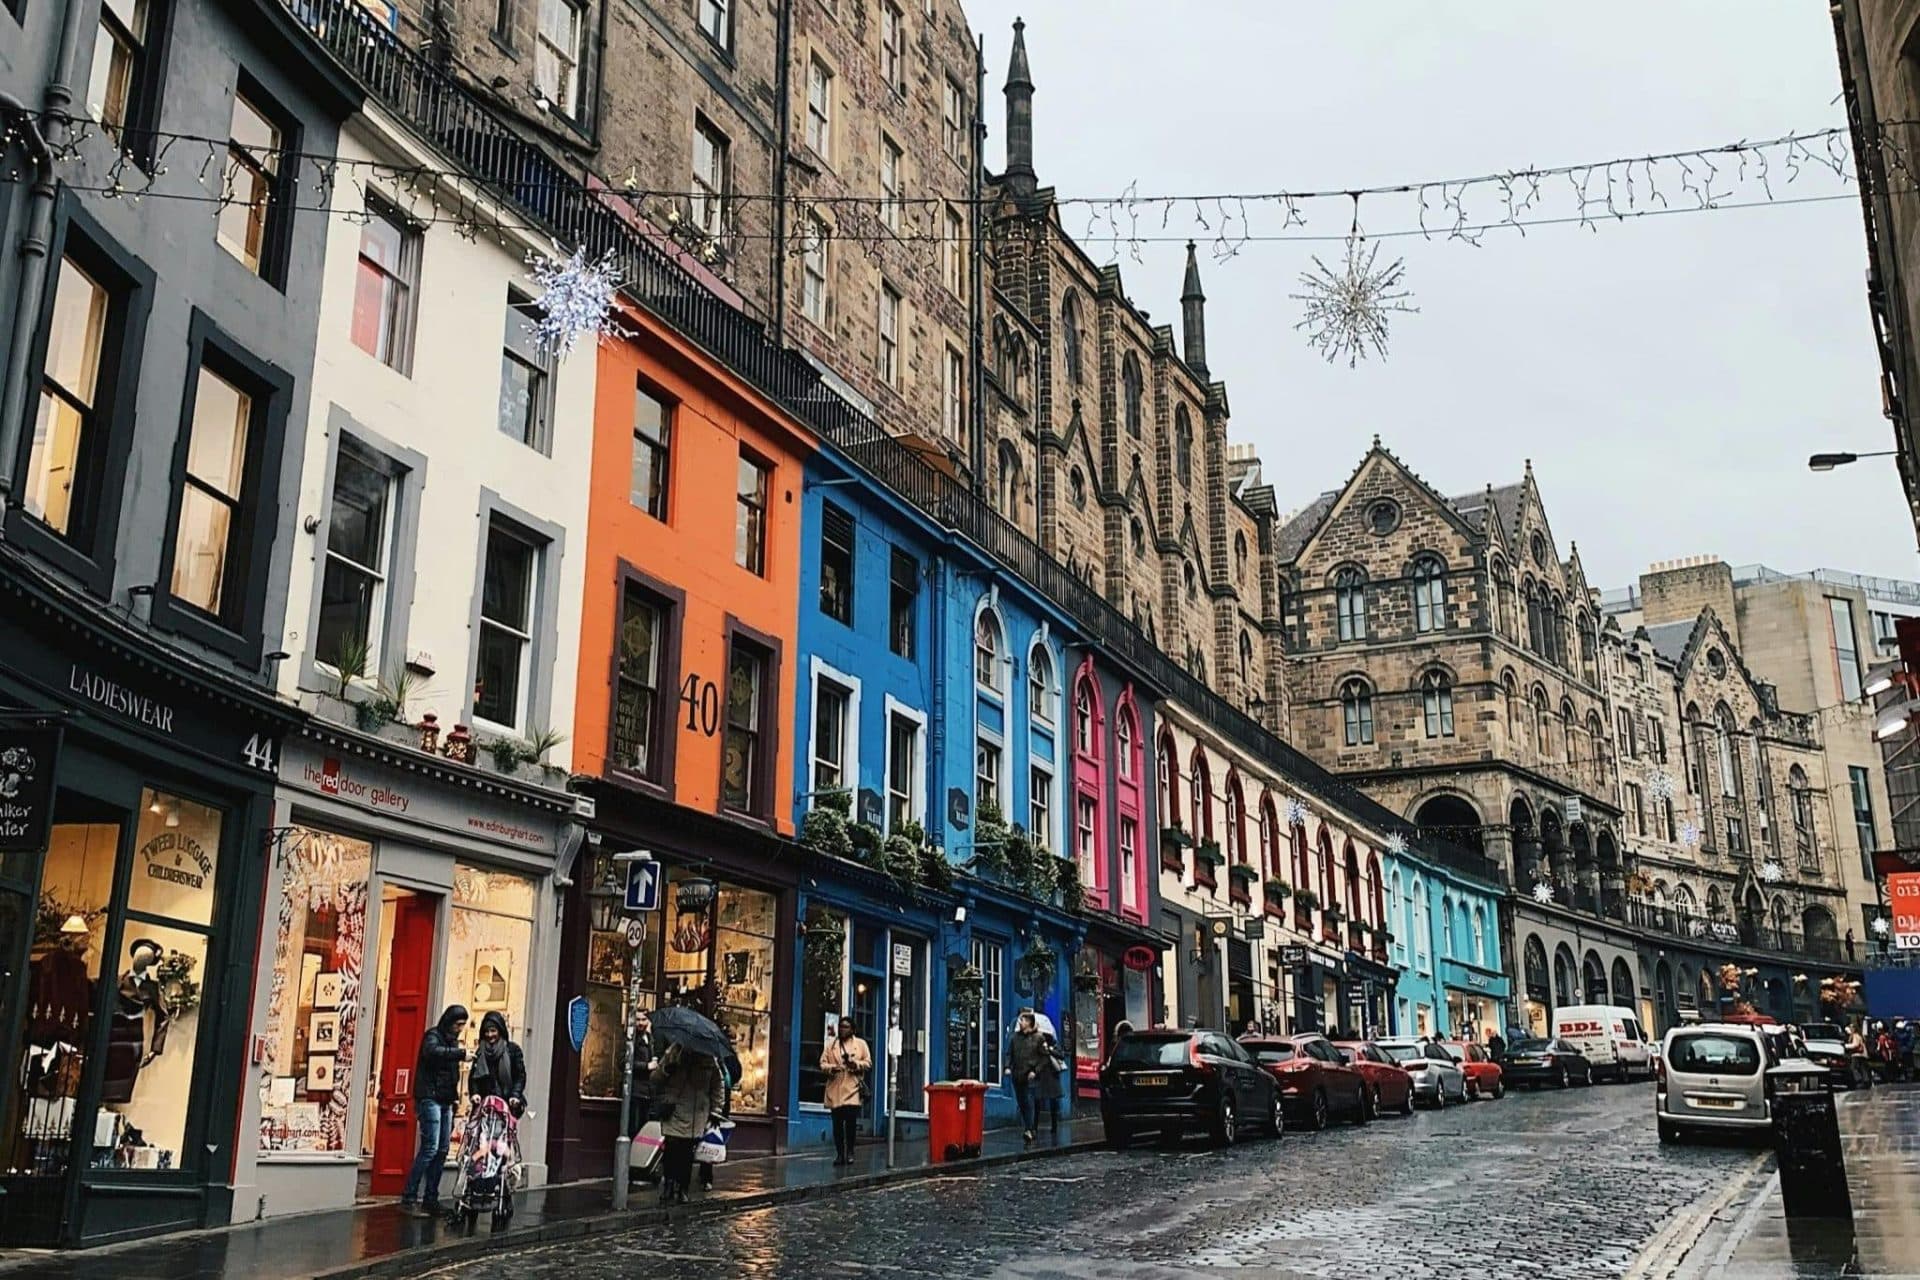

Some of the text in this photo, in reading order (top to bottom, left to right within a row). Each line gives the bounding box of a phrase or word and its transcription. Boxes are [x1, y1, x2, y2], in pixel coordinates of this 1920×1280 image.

[68, 663, 174, 733] LADIESWEAR
[304, 763, 410, 812] the red door gallery
[141, 832, 213, 879] TWEED LUGGAGE
[629, 926, 642, 938] 20
[1900, 934, 1920, 947] TO
[1559, 1022, 1603, 1033] BDL
[391, 1103, 406, 1116] 42
